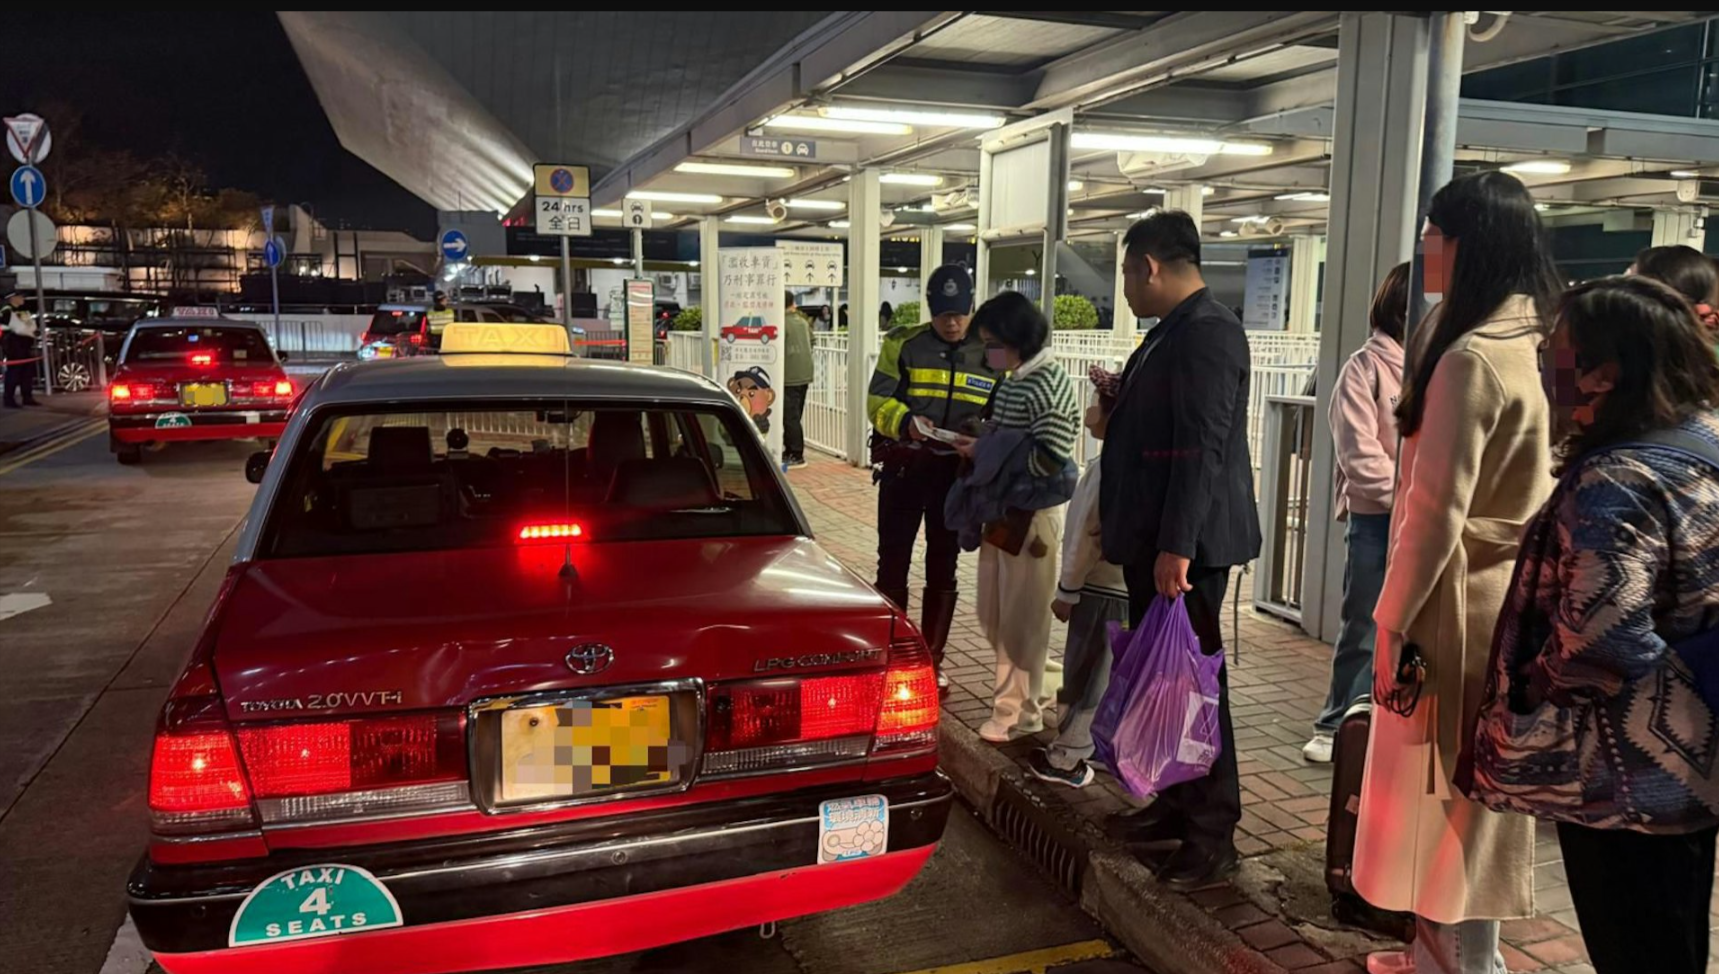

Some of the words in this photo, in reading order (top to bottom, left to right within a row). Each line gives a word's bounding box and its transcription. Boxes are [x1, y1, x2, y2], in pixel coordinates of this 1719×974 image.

[542, 201, 560, 212] 24
[563, 203, 584, 213] hrs
[549, 216, 580, 231] 全日
[724, 273, 777, 287] 乃刑事罪行
[453, 326, 559, 347] TAXI
[754, 658, 796, 672] LPG
[240, 698, 303, 712] TOYOTA
[280, 868, 345, 890] TAXI
[299, 888, 331, 915] 4
[266, 913, 367, 937] SEATS
